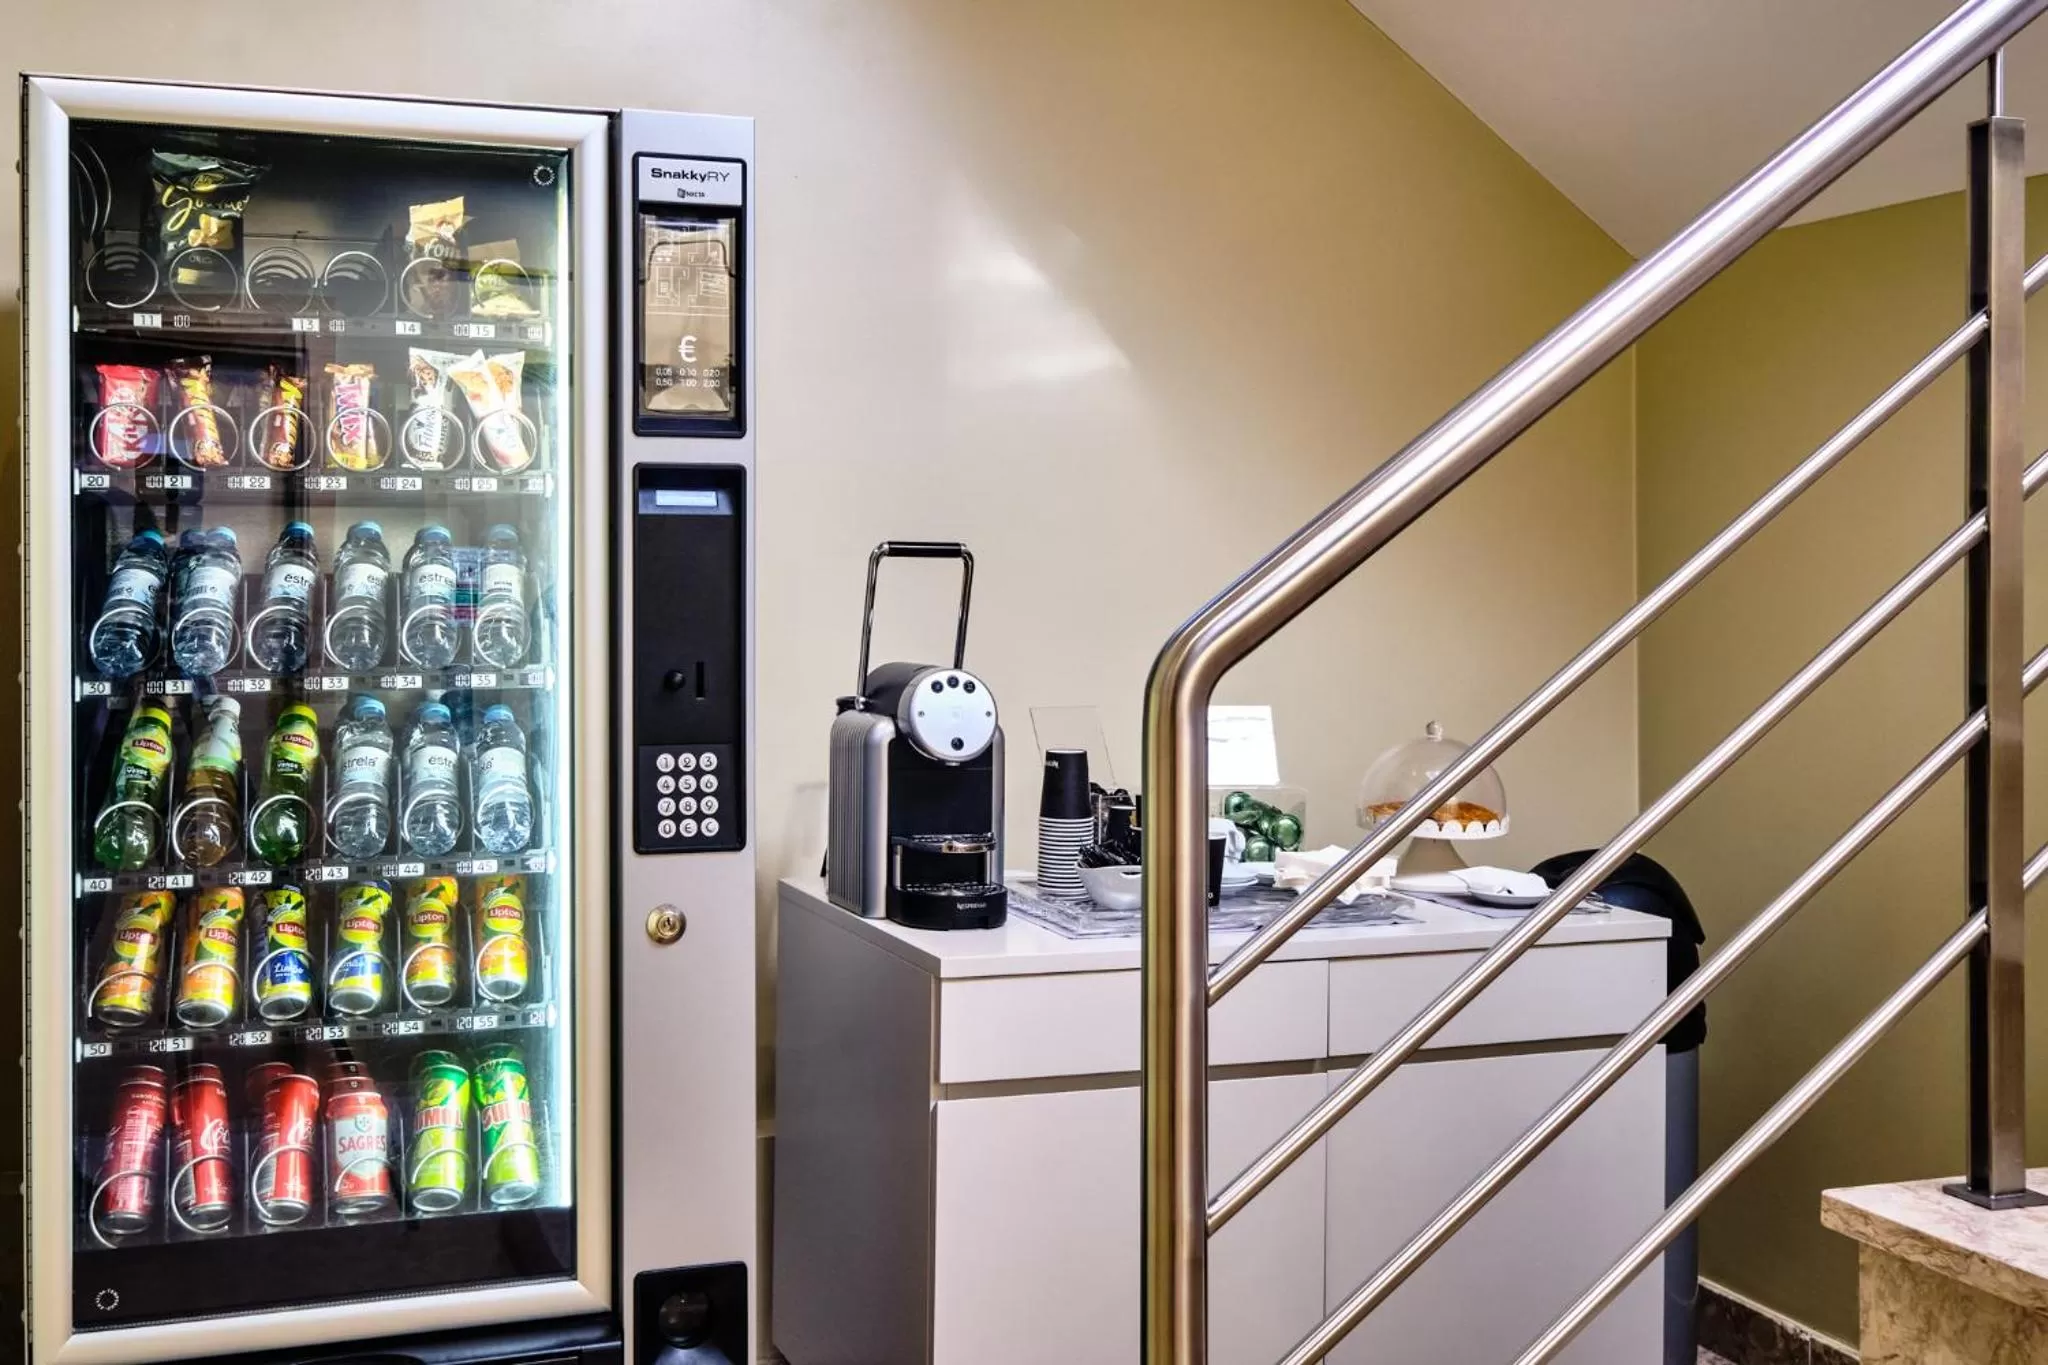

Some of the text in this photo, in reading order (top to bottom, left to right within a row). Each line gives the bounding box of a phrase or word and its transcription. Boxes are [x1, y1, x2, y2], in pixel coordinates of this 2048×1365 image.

[651, 167, 730, 182] SnakkyRY
[140, 314, 155, 326] 11
[402, 323, 416, 333] 14
[475, 326, 489, 337] 15
[678, 335, 697, 363] €
[335, 381, 361, 446] TWIX
[87, 476, 105, 487] 20
[170, 475, 185, 487] 21
[249, 476, 265, 488] 22
[326, 478, 341, 489] 23
[401, 478, 417, 489] 24
[477, 479, 492, 490] 25
[171, 681, 185, 693] 31
[250, 679, 266, 691] 32
[328, 677, 343, 688] 33
[401, 676, 416, 687] 34
[477, 676, 491, 687] 35
[88, 682, 105, 694] 30
[662, 756, 712, 769] 1 2 3
[662, 778, 713, 791] 4 5 6
[663, 799, 713, 813] 7 8 9
[663, 823, 671, 835] 0
[705, 821, 713, 833] C
[403, 863, 419, 874] 44
[477, 860, 493, 871] 45
[250, 871, 267, 882] 42
[327, 867, 343, 878] 43
[90, 880, 107, 891] 40
[171, 875, 187, 887] 41
[413, 912, 446, 924] Lipton
[489, 906, 522, 919] Lipton
[346, 919, 379, 931] Lipton
[403, 1021, 418, 1032] 54
[479, 1016, 494, 1027] 55
[250, 1032, 267, 1044] 52
[329, 1027, 344, 1038] 53
[172, 1039, 187, 1050] 51
[90, 1045, 107, 1056] 50
[338, 1133, 386, 1155] SAGRES
